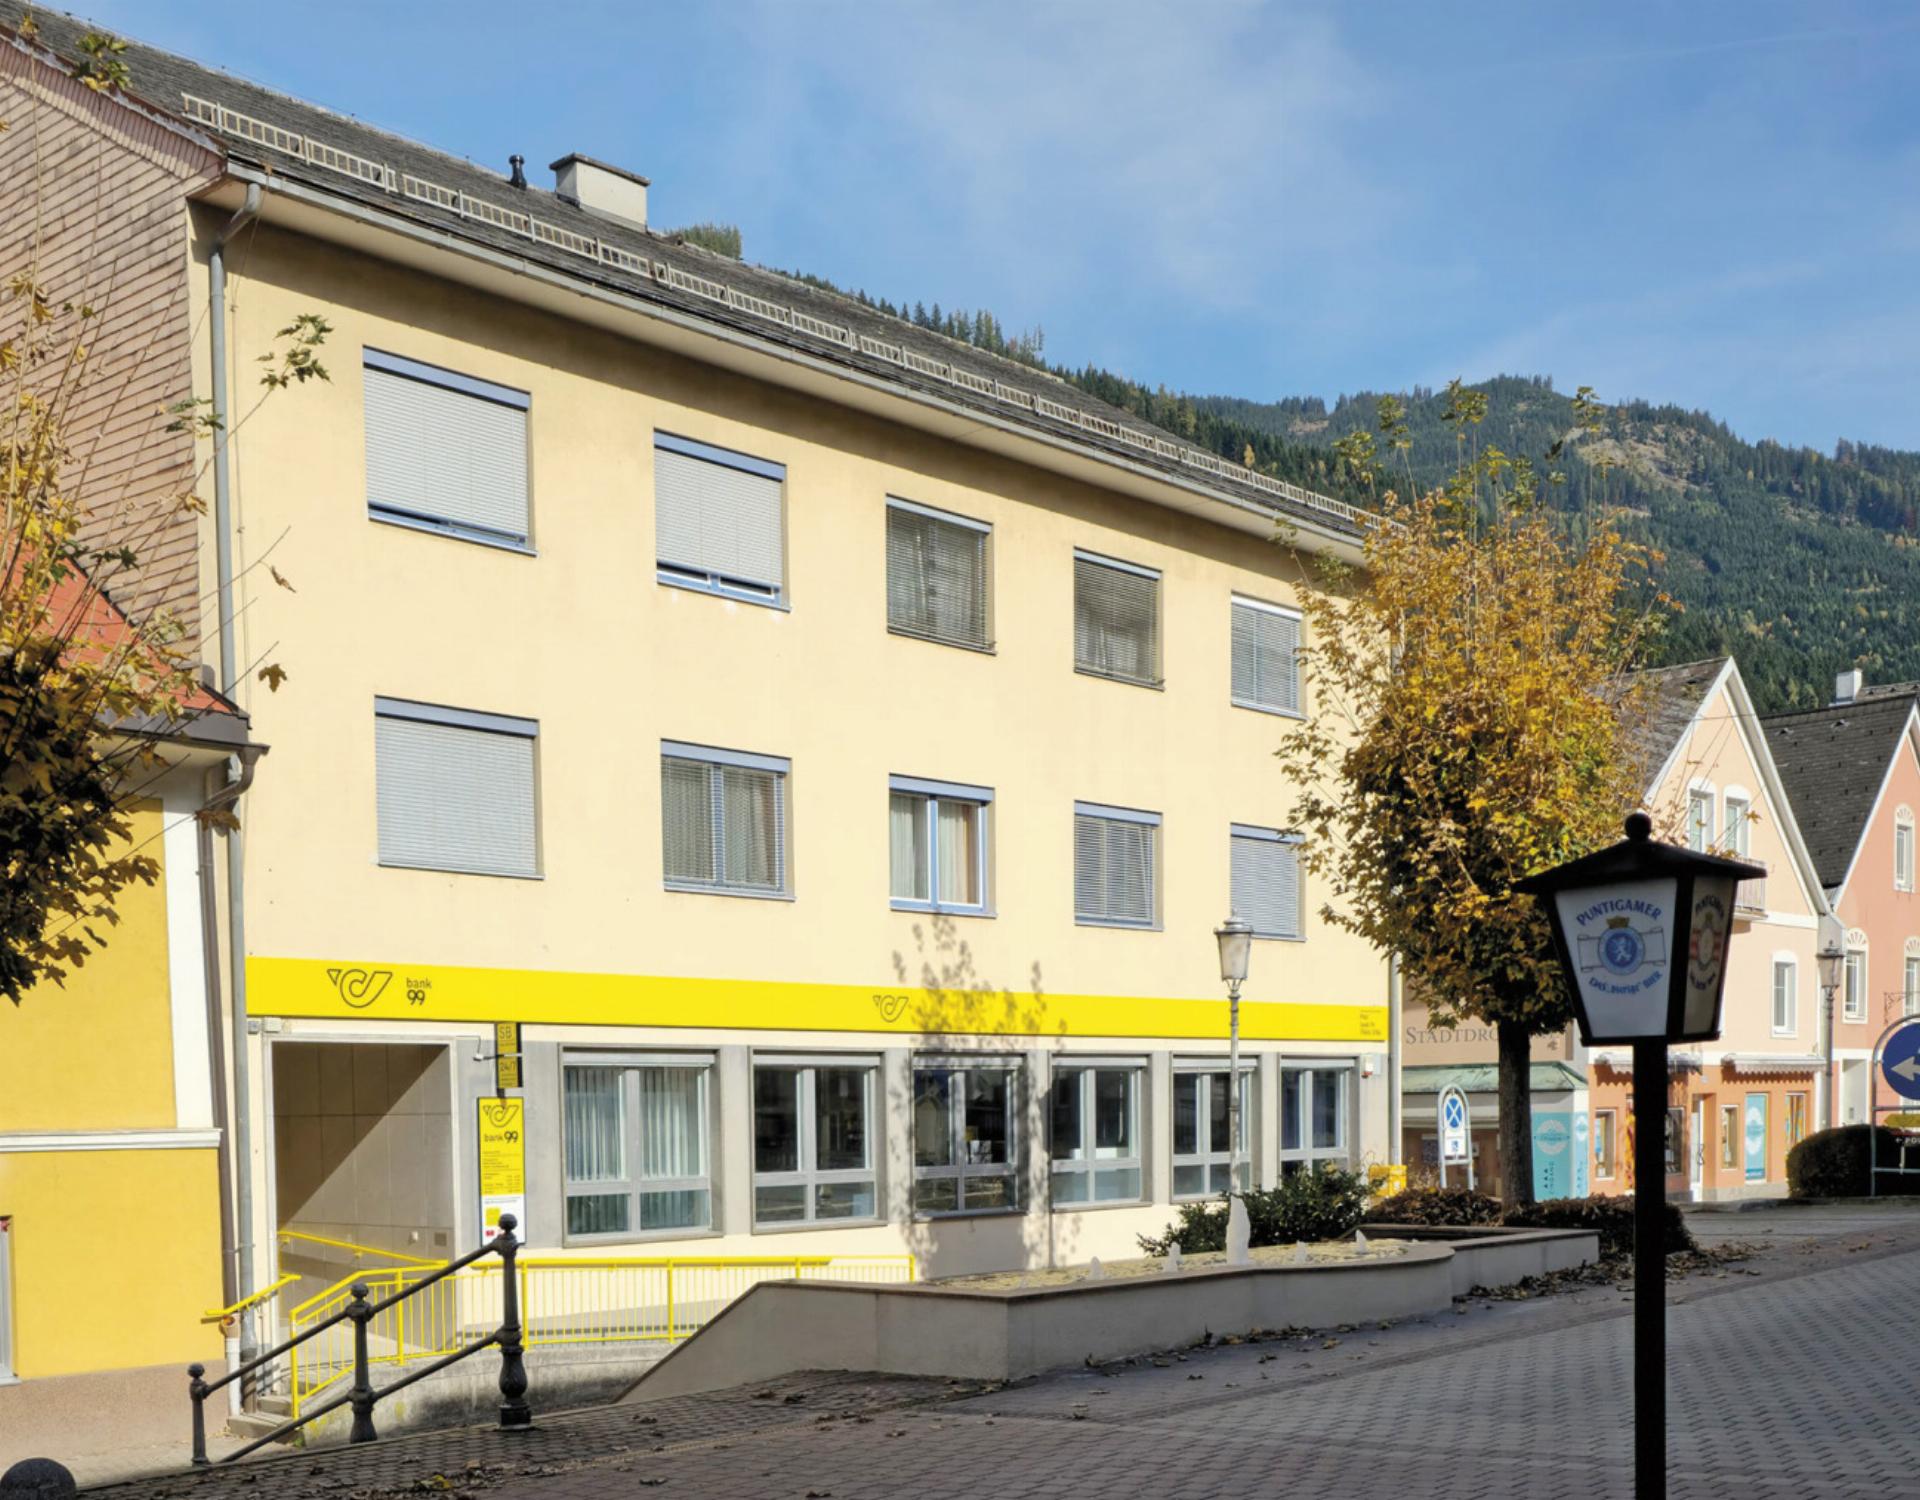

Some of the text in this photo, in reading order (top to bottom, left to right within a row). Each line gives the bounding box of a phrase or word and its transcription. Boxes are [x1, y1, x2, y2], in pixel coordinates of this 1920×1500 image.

[1576, 899, 1662, 926] PUNTIGAMER
[406, 976, 432, 989] bank
[407, 989, 425, 1006] 99
[499, 1025, 512, 1039] SB
